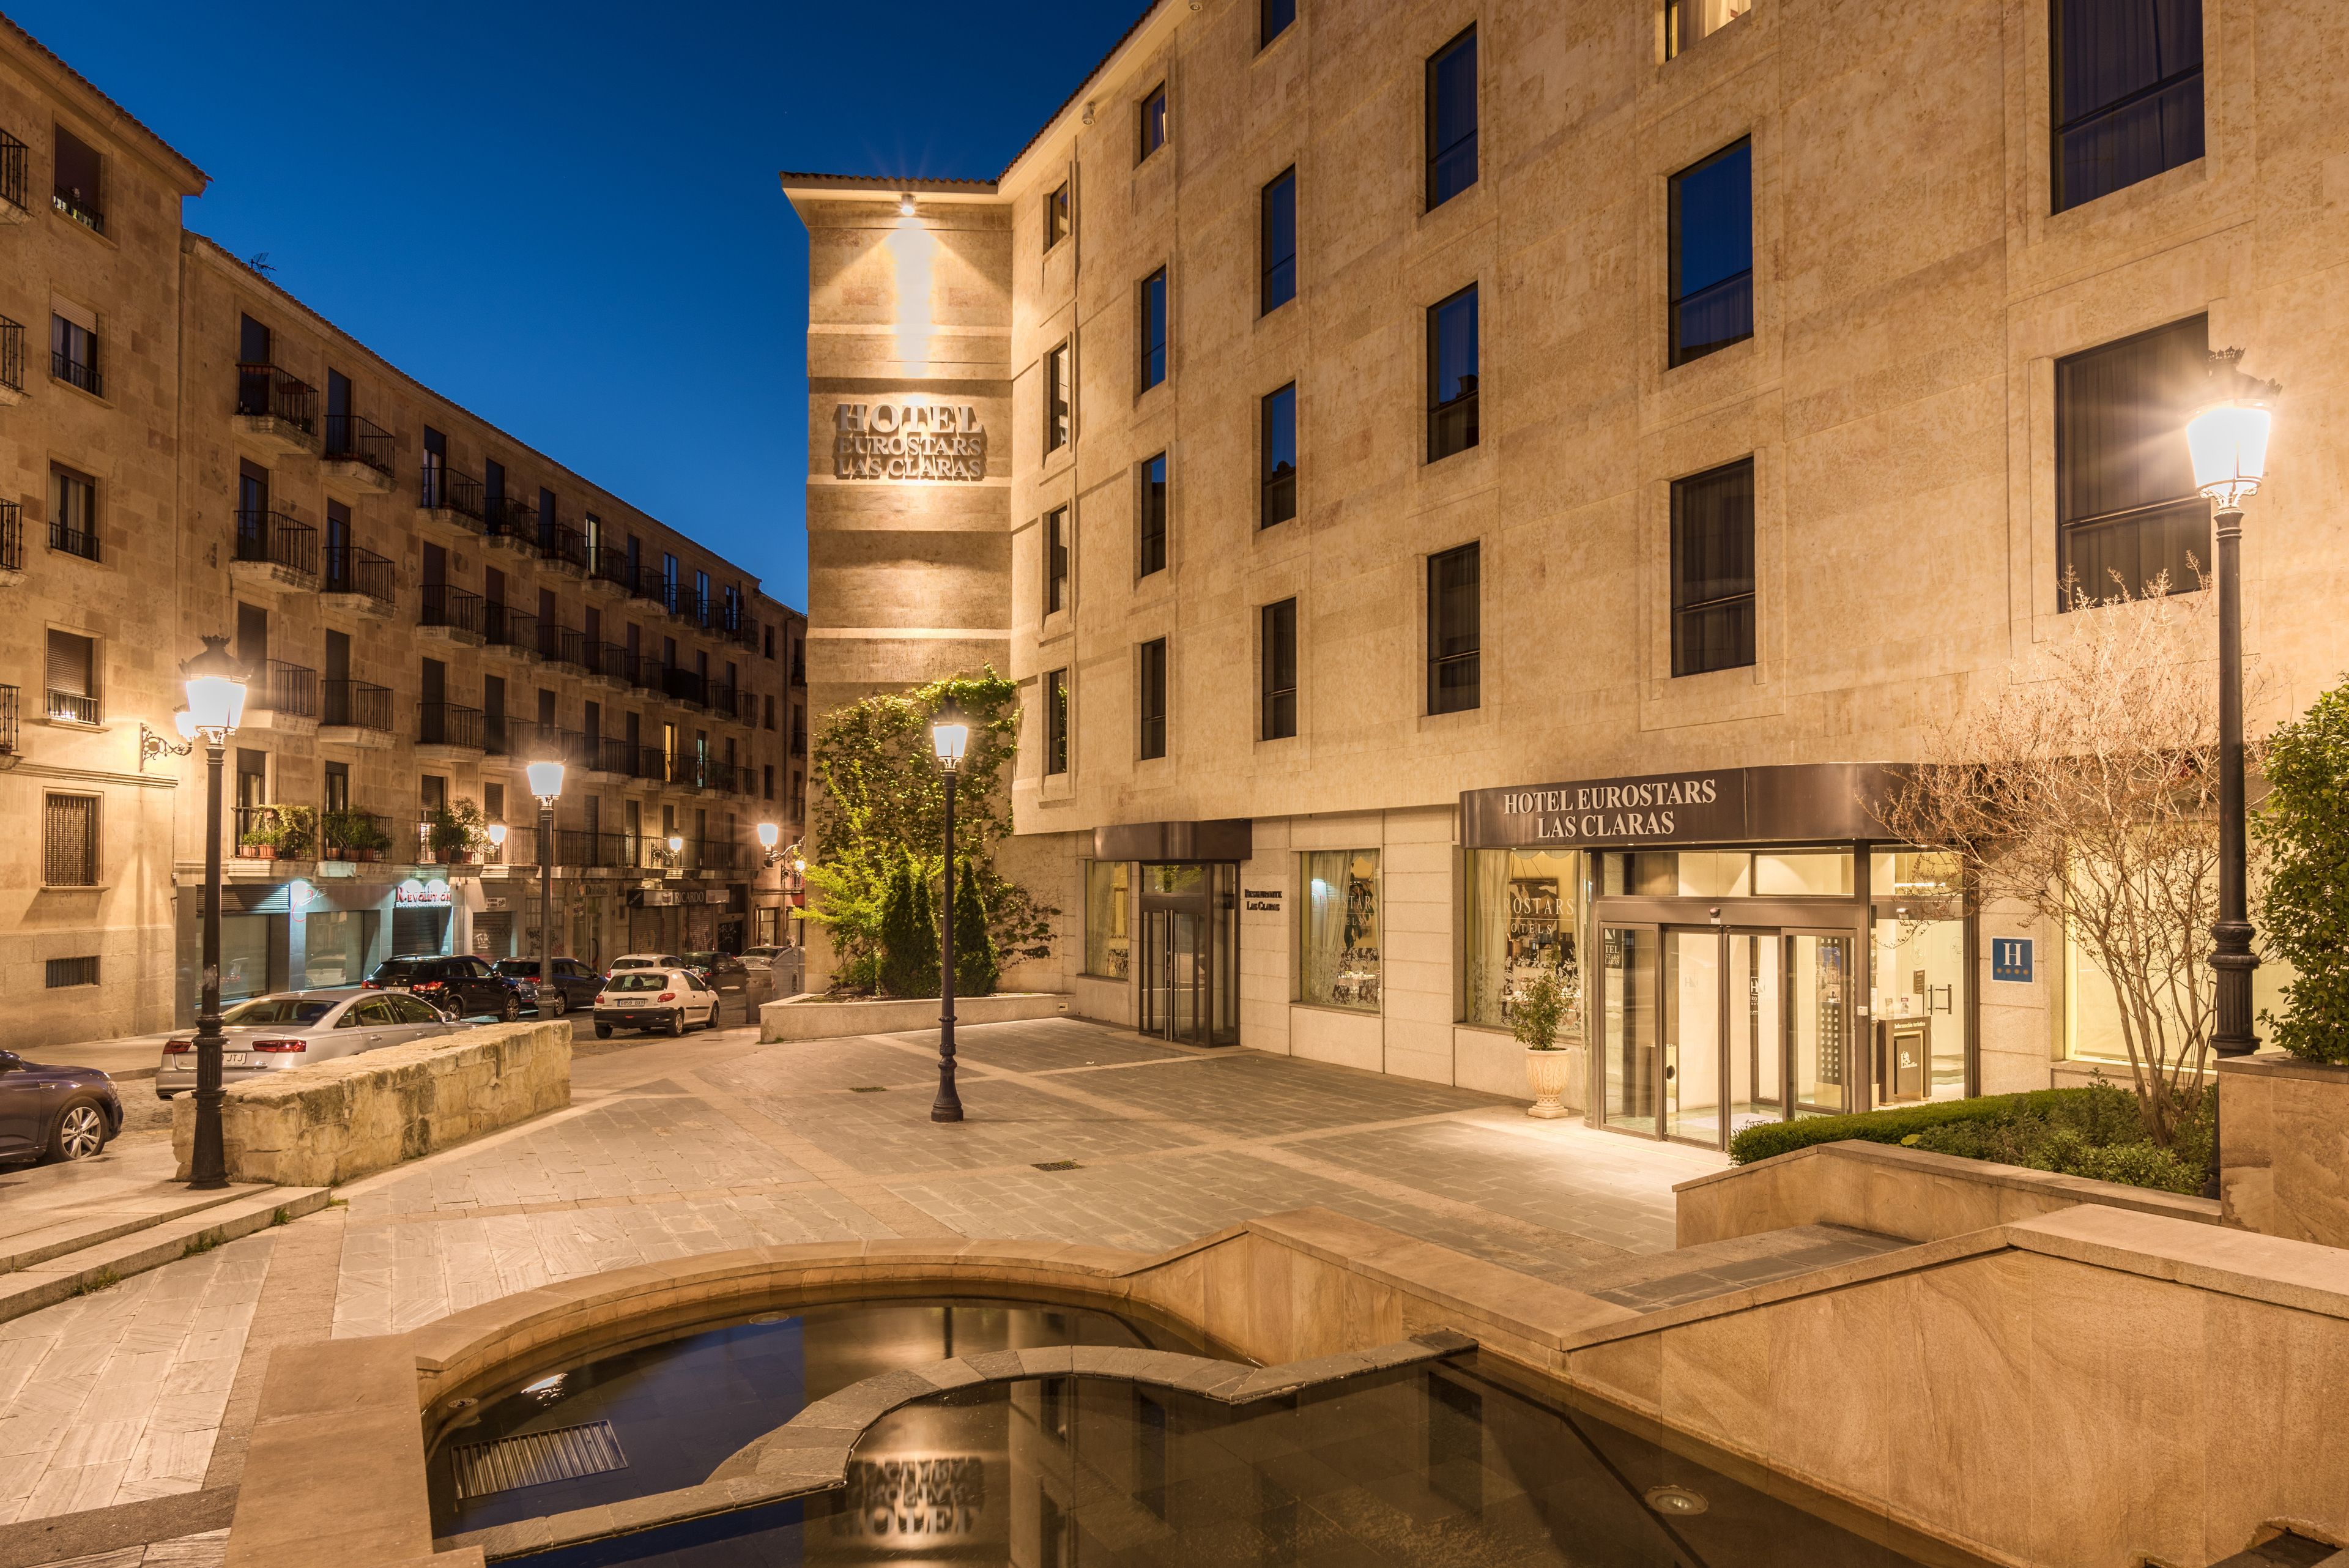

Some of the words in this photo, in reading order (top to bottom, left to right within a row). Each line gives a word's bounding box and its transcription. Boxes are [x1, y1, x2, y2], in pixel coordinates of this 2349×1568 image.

[837, 403, 982, 433] HOTEL
[839, 437, 982, 456] EUROSTARS
[839, 458, 881, 476] LAS
[888, 458, 981, 477] CLARAS
[1504, 790, 1574, 814] HOTEL
[1577, 779, 1716, 810] EUROSTARS
[1537, 815, 1576, 838] LAS
[1581, 811, 1675, 836] CLARAS
[675, 891, 703, 903] RICARDO
[1605, 945, 1620, 954] TEL
[2003, 943, 2023, 966] H
